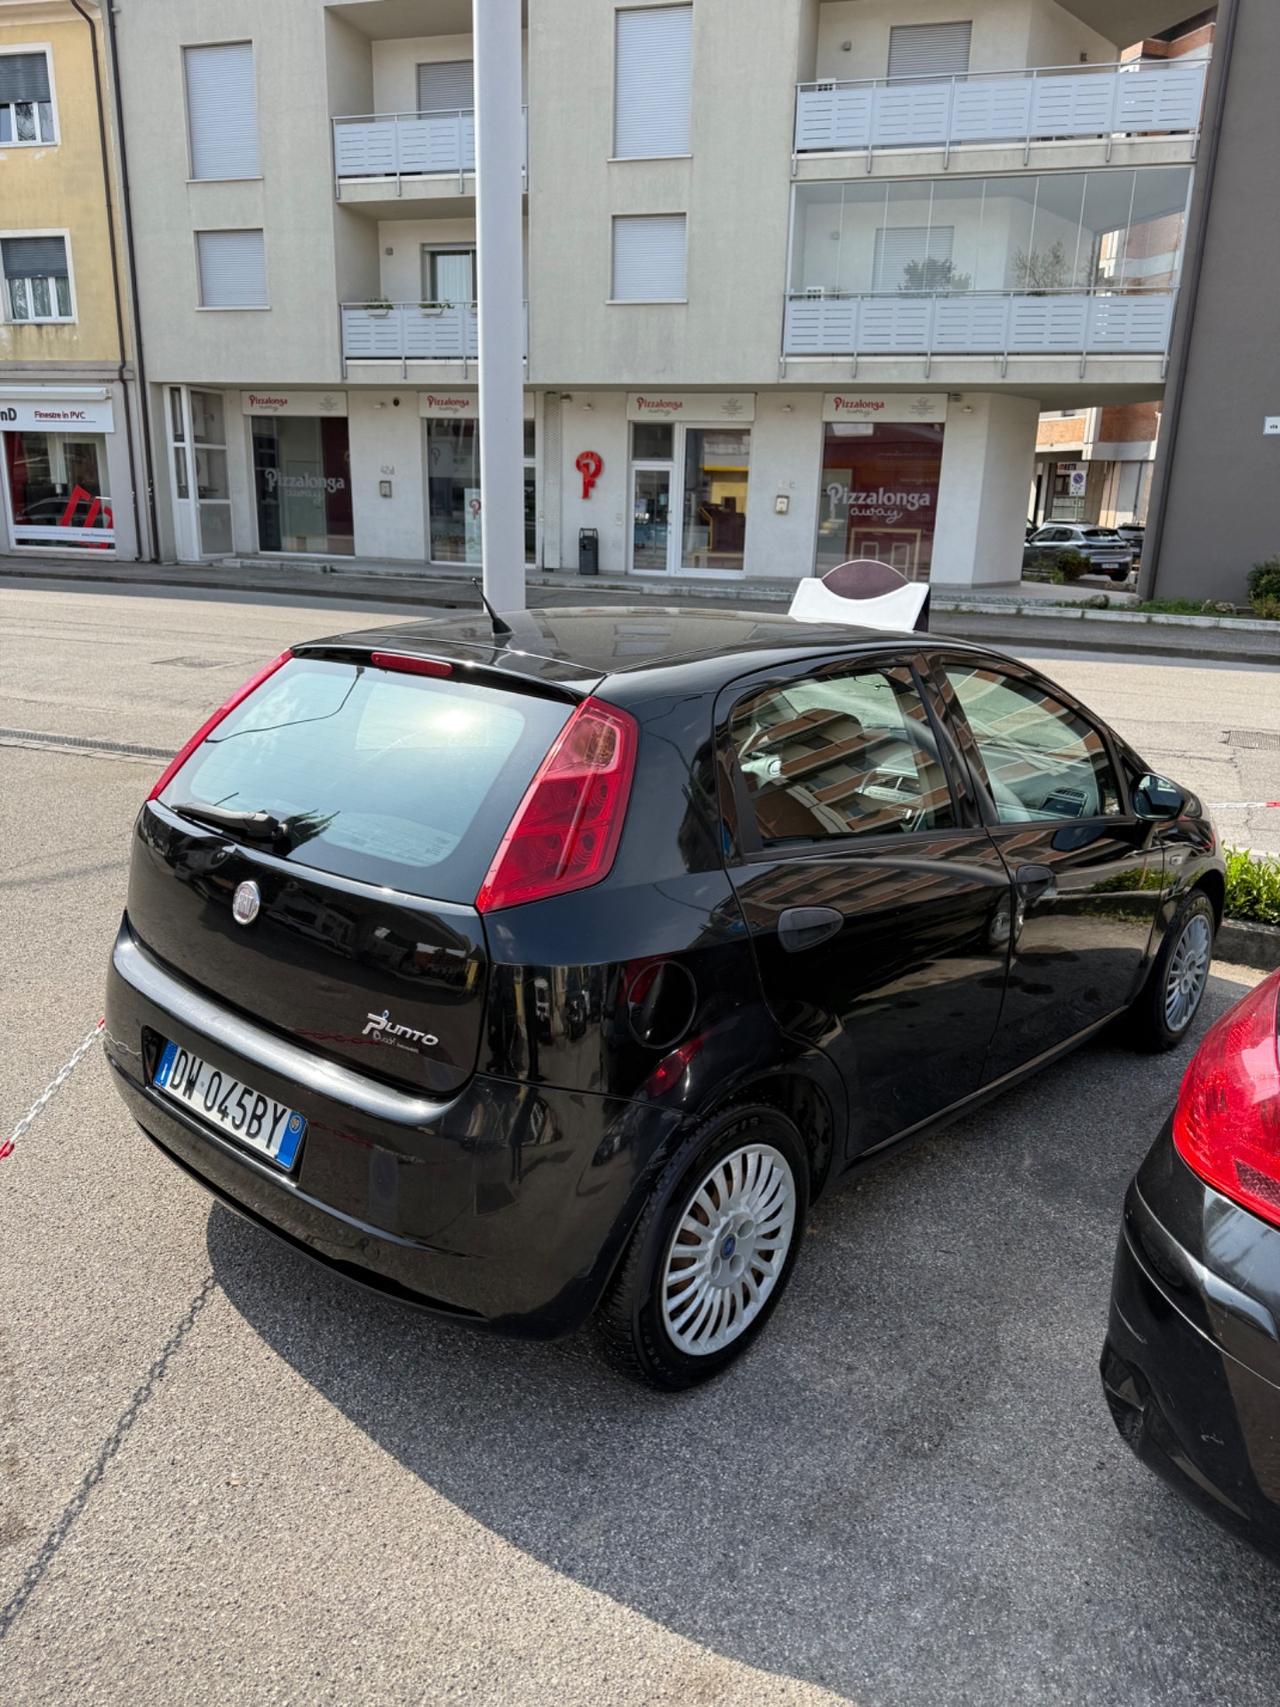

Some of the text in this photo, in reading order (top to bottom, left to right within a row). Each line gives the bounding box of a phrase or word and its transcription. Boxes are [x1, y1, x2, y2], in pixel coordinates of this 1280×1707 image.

[248, 394, 288, 407] Pizzalonga
[427, 395, 469, 408] Pizzalonga
[636, 396, 683, 410] Pizzalonga
[833, 396, 885, 411] Pizzalonga
[34, 410, 86, 420] Finestre in PVC
[264, 468, 345, 493] Pizzalonga
[827, 482, 931, 520] Pizzalonga
[850, 506, 903, 524] away
[169, 1049, 287, 1150] DW 045BY
